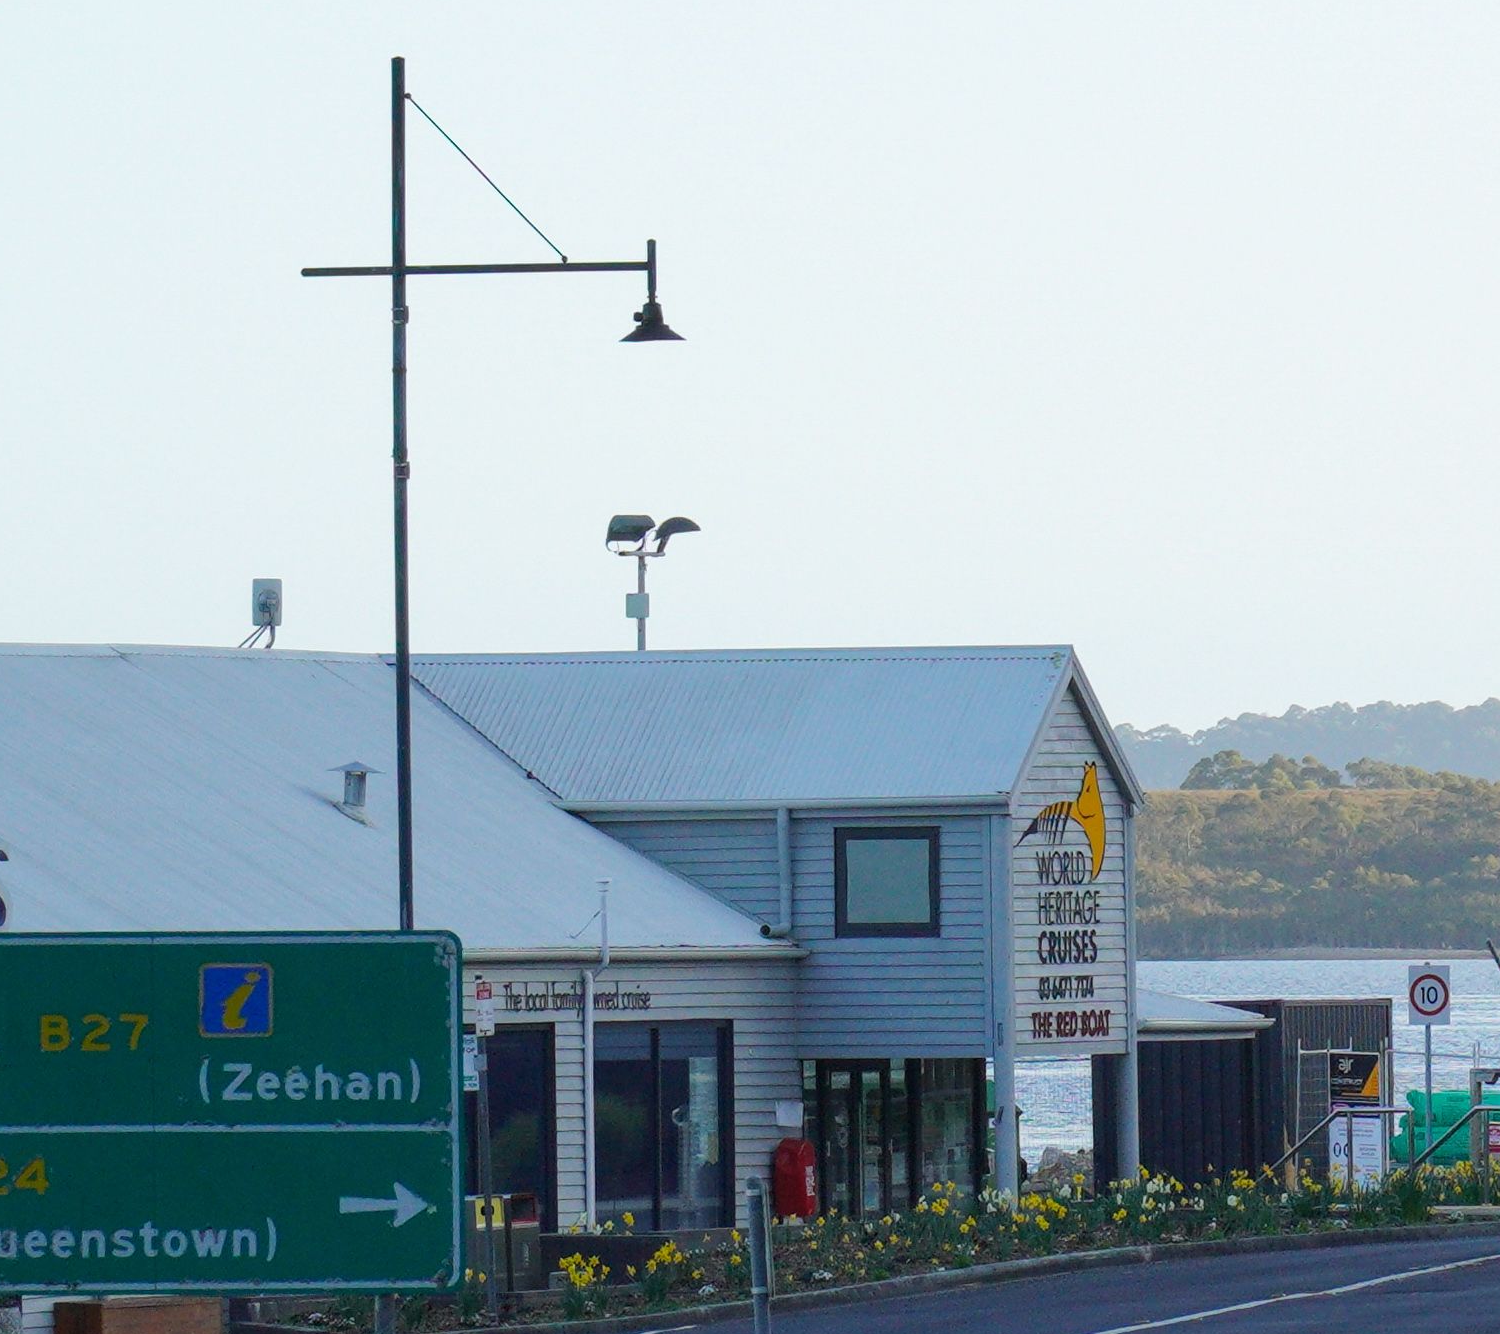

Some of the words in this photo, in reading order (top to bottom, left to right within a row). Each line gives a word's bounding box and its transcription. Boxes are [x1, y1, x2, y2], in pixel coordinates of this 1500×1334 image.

[1036, 851, 1086, 885] WORLD
[1038, 890, 1100, 925] HERITAGE
[1038, 929, 1098, 964] CRUISES
[503, 982, 522, 1011] The
[1421, 986, 1438, 1004] 10
[40, 1013, 149, 1053] B27
[1031, 1012, 1053, 1039] THE
[1057, 1011, 1078, 1038] RED
[1081, 1009, 1110, 1037] BOAT
[199, 1057, 421, 1104] (Zeehan)
